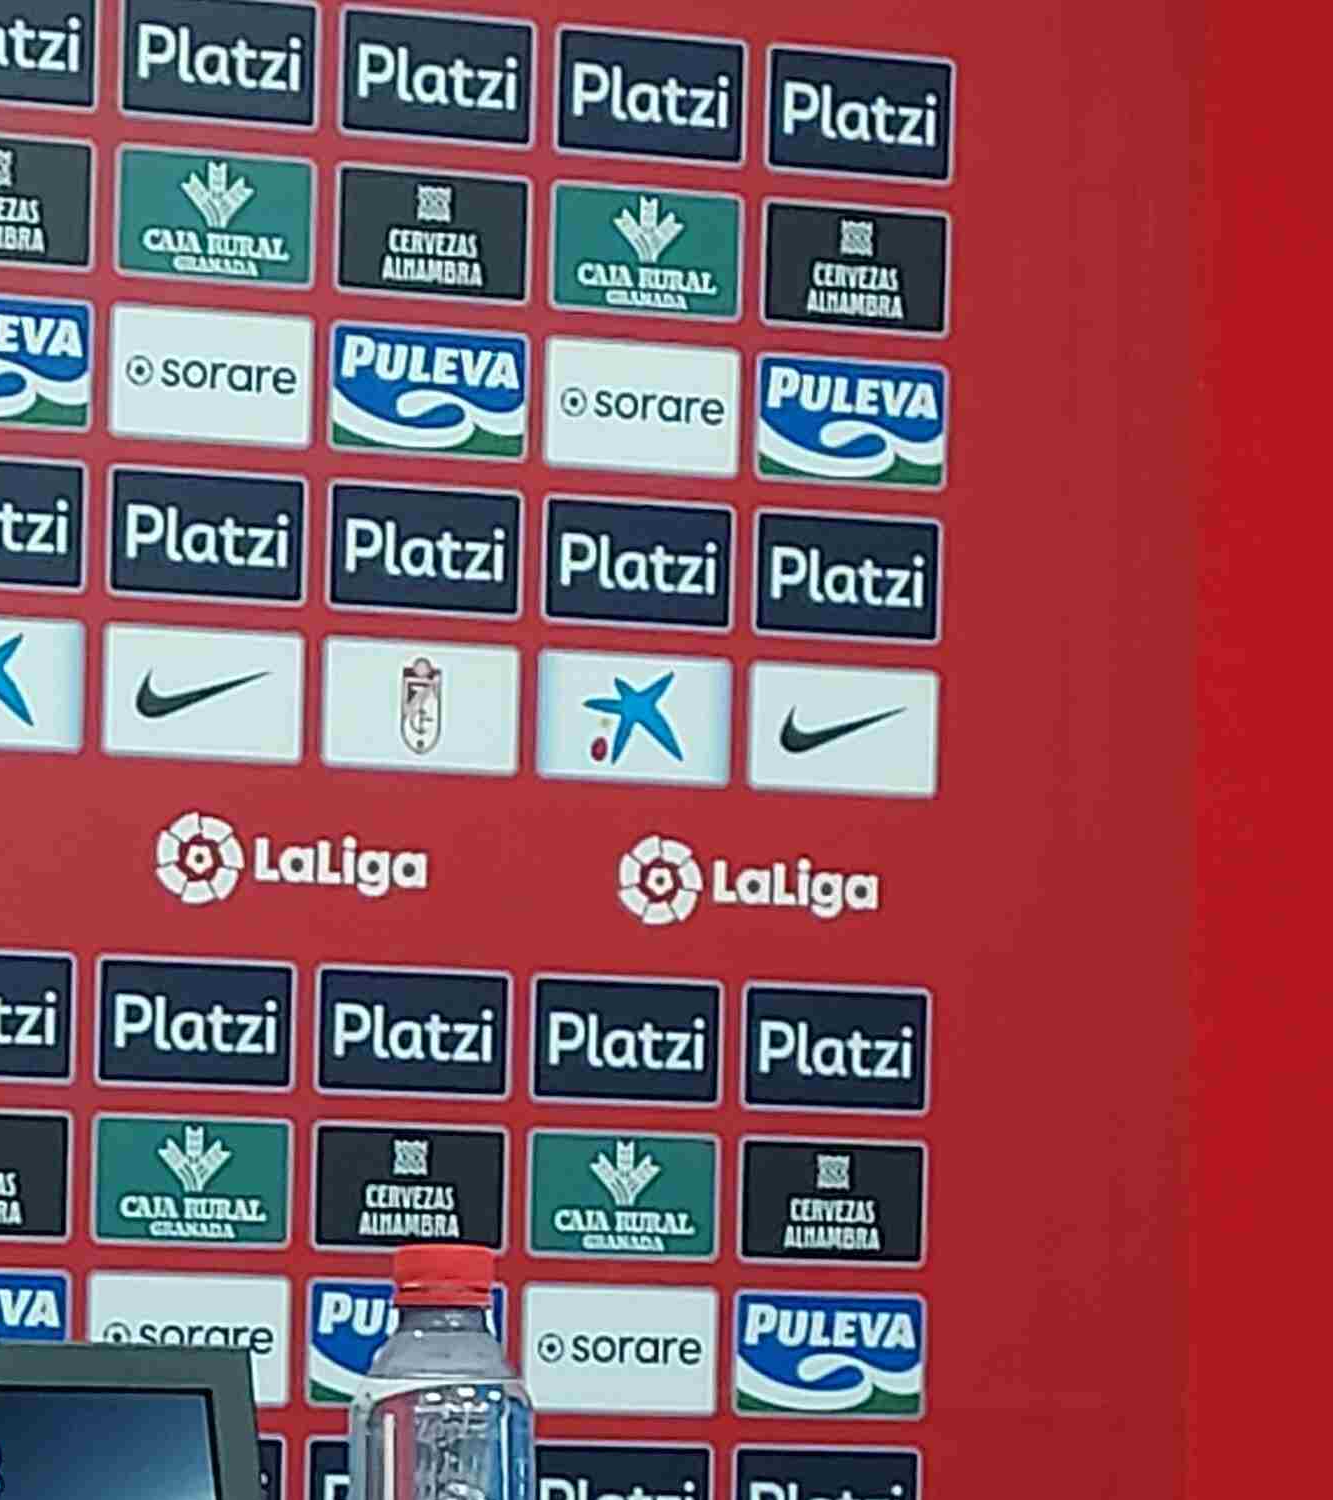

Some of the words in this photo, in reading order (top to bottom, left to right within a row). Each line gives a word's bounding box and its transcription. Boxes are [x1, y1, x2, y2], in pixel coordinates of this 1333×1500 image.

[138, 24, 301, 91] Platzi
[358, 44, 517, 110] Platzi
[573, 63, 728, 128] Platzi
[784, 82, 936, 146] Platzi
[142, 229, 202, 255] CAJA
[207, 234, 291, 262] RURAL
[388, 226, 478, 259] CERVEZAS
[173, 256, 259, 278] GRANADA
[381, 254, 483, 288] ALHAMBRA
[577, 262, 634, 289] CAJA
[639, 268, 718, 296] RURAL
[813, 260, 899, 291] CERVEZAS
[606, 291, 689, 311] GRANADA
[806, 288, 904, 320] ALHAMBRA
[161, 359, 296, 394] sorare
[341, 335, 519, 389] PULEVA
[594, 391, 724, 426] sorare
[767, 366, 937, 419] PULEVA
[127, 504, 289, 568] Platzi
[345, 519, 505, 581] Platzi
[560, 533, 717, 594] Platzi
[771, 546, 924, 607] Platzi
[255, 836, 427, 896] LaLiga
[713, 859, 878, 917] LaLiga
[115, 994, 276, 1053] Platzi
[334, 1003, 493, 1062] Platzi
[549, 1012, 704, 1070] Platzi
[760, 1021, 912, 1078] Platzi
[119, 1196, 178, 1220] CAJA
[183, 1198, 265, 1222] RURAL
[365, 1182, 455, 1212] CERVEZAS
[789, 1198, 875, 1225] CERVEZAS
[151, 1220, 235, 1239] GRANADA
[358, 1209, 460, 1240] ALHAMBRA
[554, 1208, 612, 1234] CAJA
[615, 1211, 695, 1236] RURAL
[783, 1224, 881, 1251] ALHAMBRA
[582, 1232, 665, 1252] GRANADA
[139, 1324, 275, 1354] sorare
[745, 1304, 915, 1348] PULEVA
[572, 1335, 701, 1365] sorare
